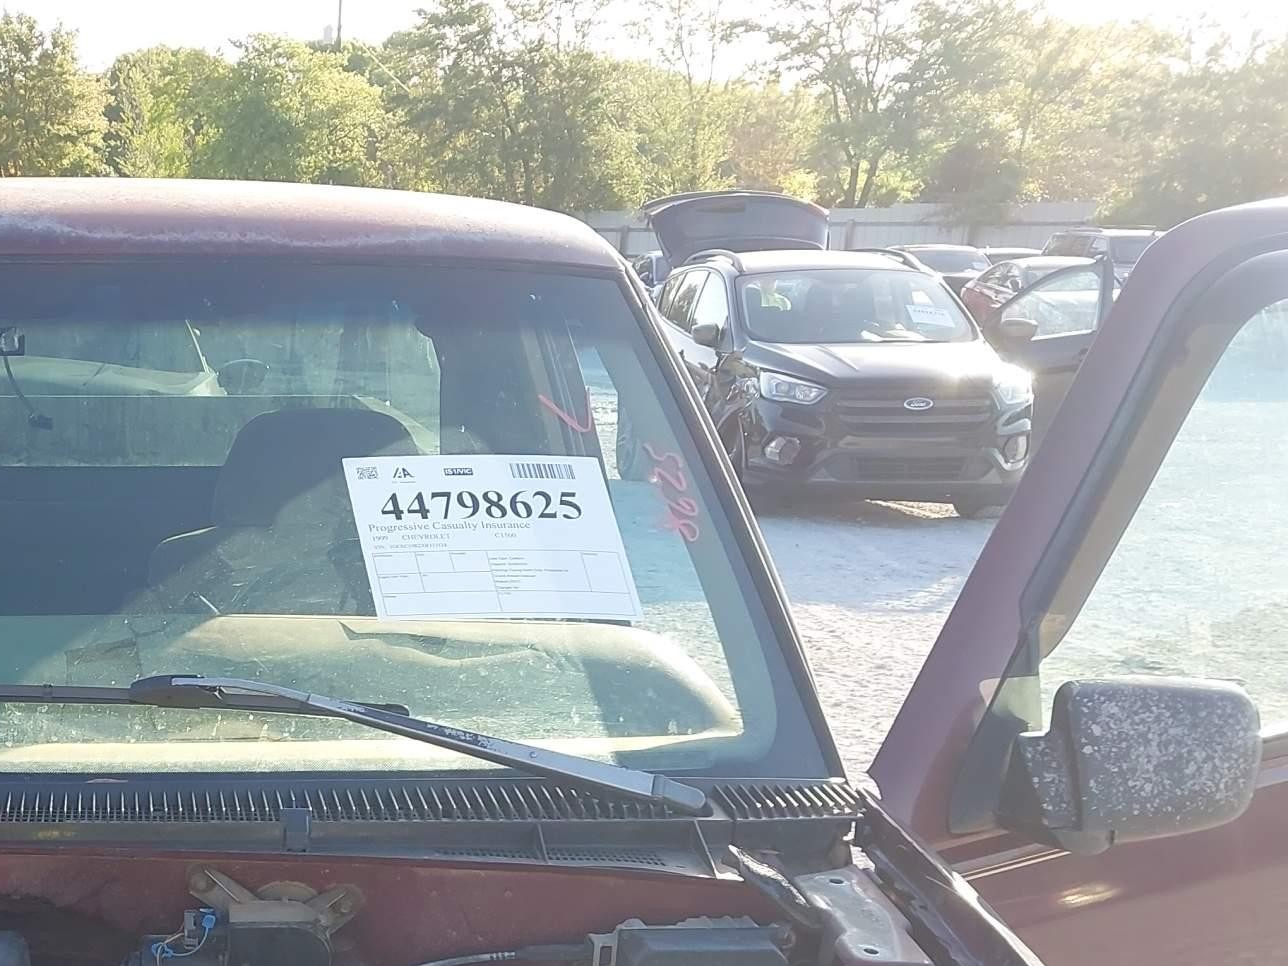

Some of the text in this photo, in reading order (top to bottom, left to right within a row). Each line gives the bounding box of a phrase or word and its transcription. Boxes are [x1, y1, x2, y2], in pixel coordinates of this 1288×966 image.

[381, 490, 583, 521] 44798625
[368, 520, 531, 533] Progressive Casualty Insurance
[401, 533, 451, 541] CHEVROLET
